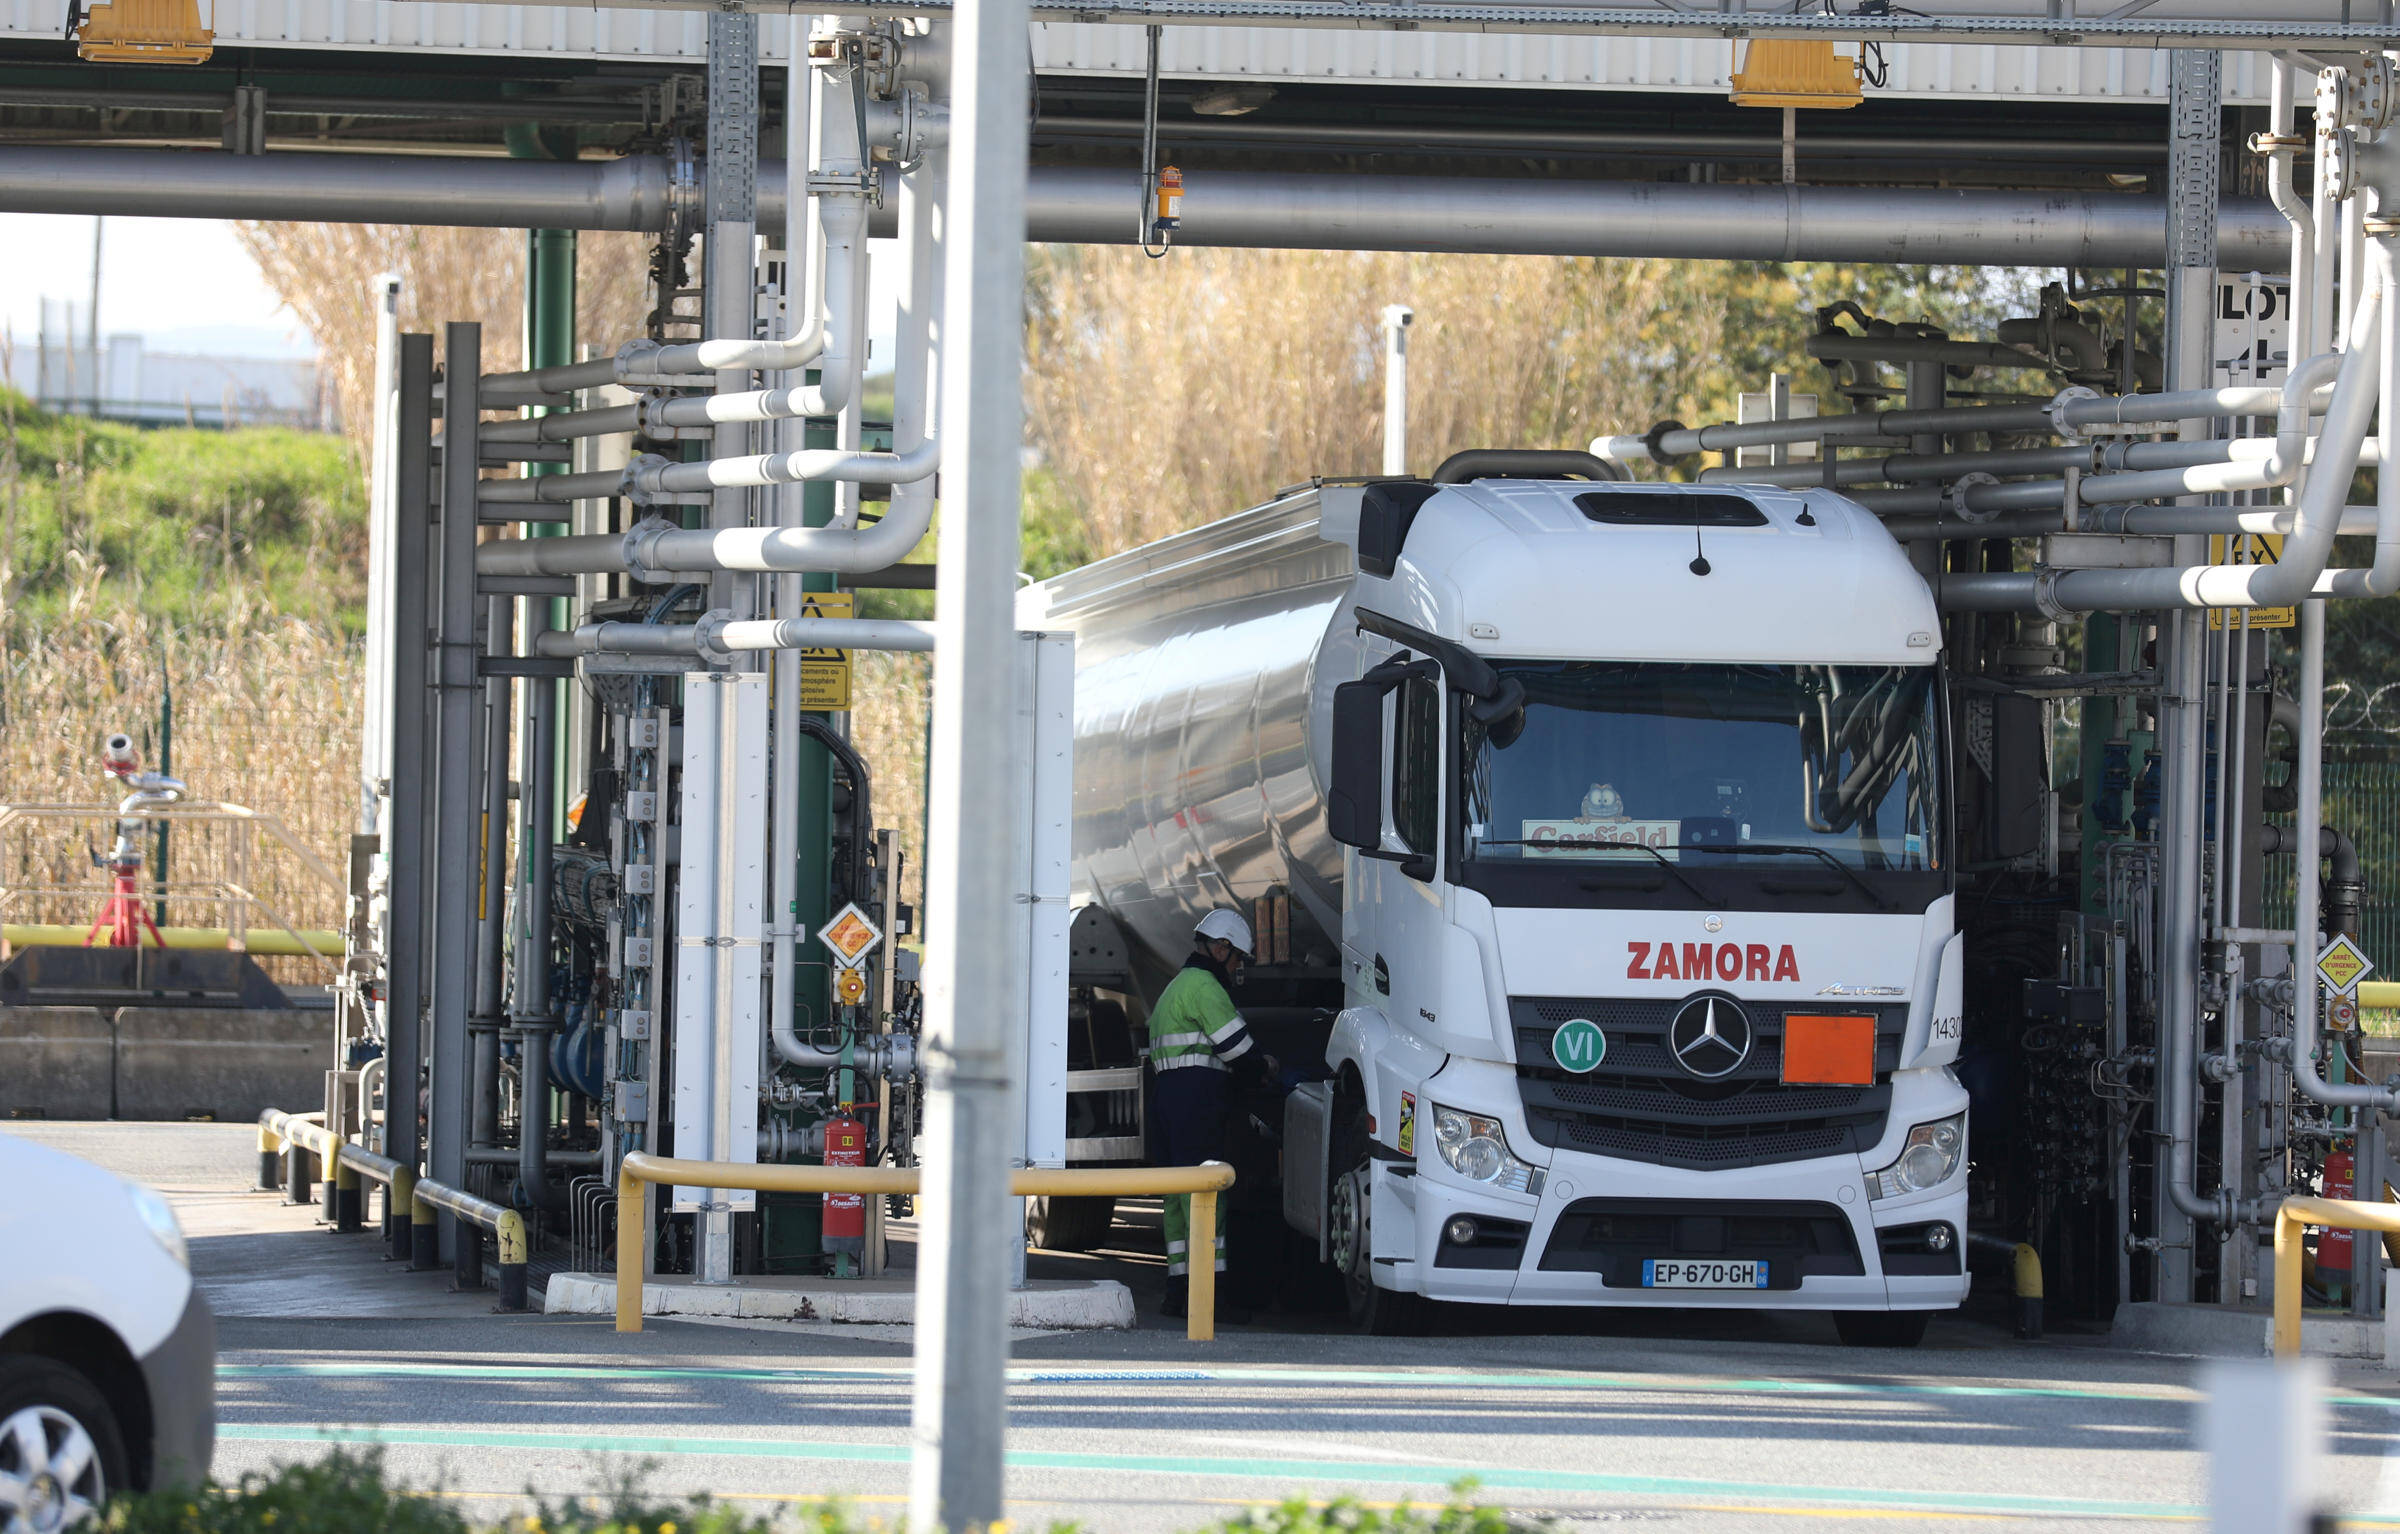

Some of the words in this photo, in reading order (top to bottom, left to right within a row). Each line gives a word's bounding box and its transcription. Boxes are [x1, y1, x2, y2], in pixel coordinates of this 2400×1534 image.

[2216, 285, 2291, 321] LOT
[2237, 339, 2272, 379] 4
[1627, 941, 1800, 982] ZAMORA
[1932, 1016, 1963, 1040] 1430
[1563, 1031, 1593, 1061] VI
[1655, 1264, 1754, 1283] EP-670-GH
